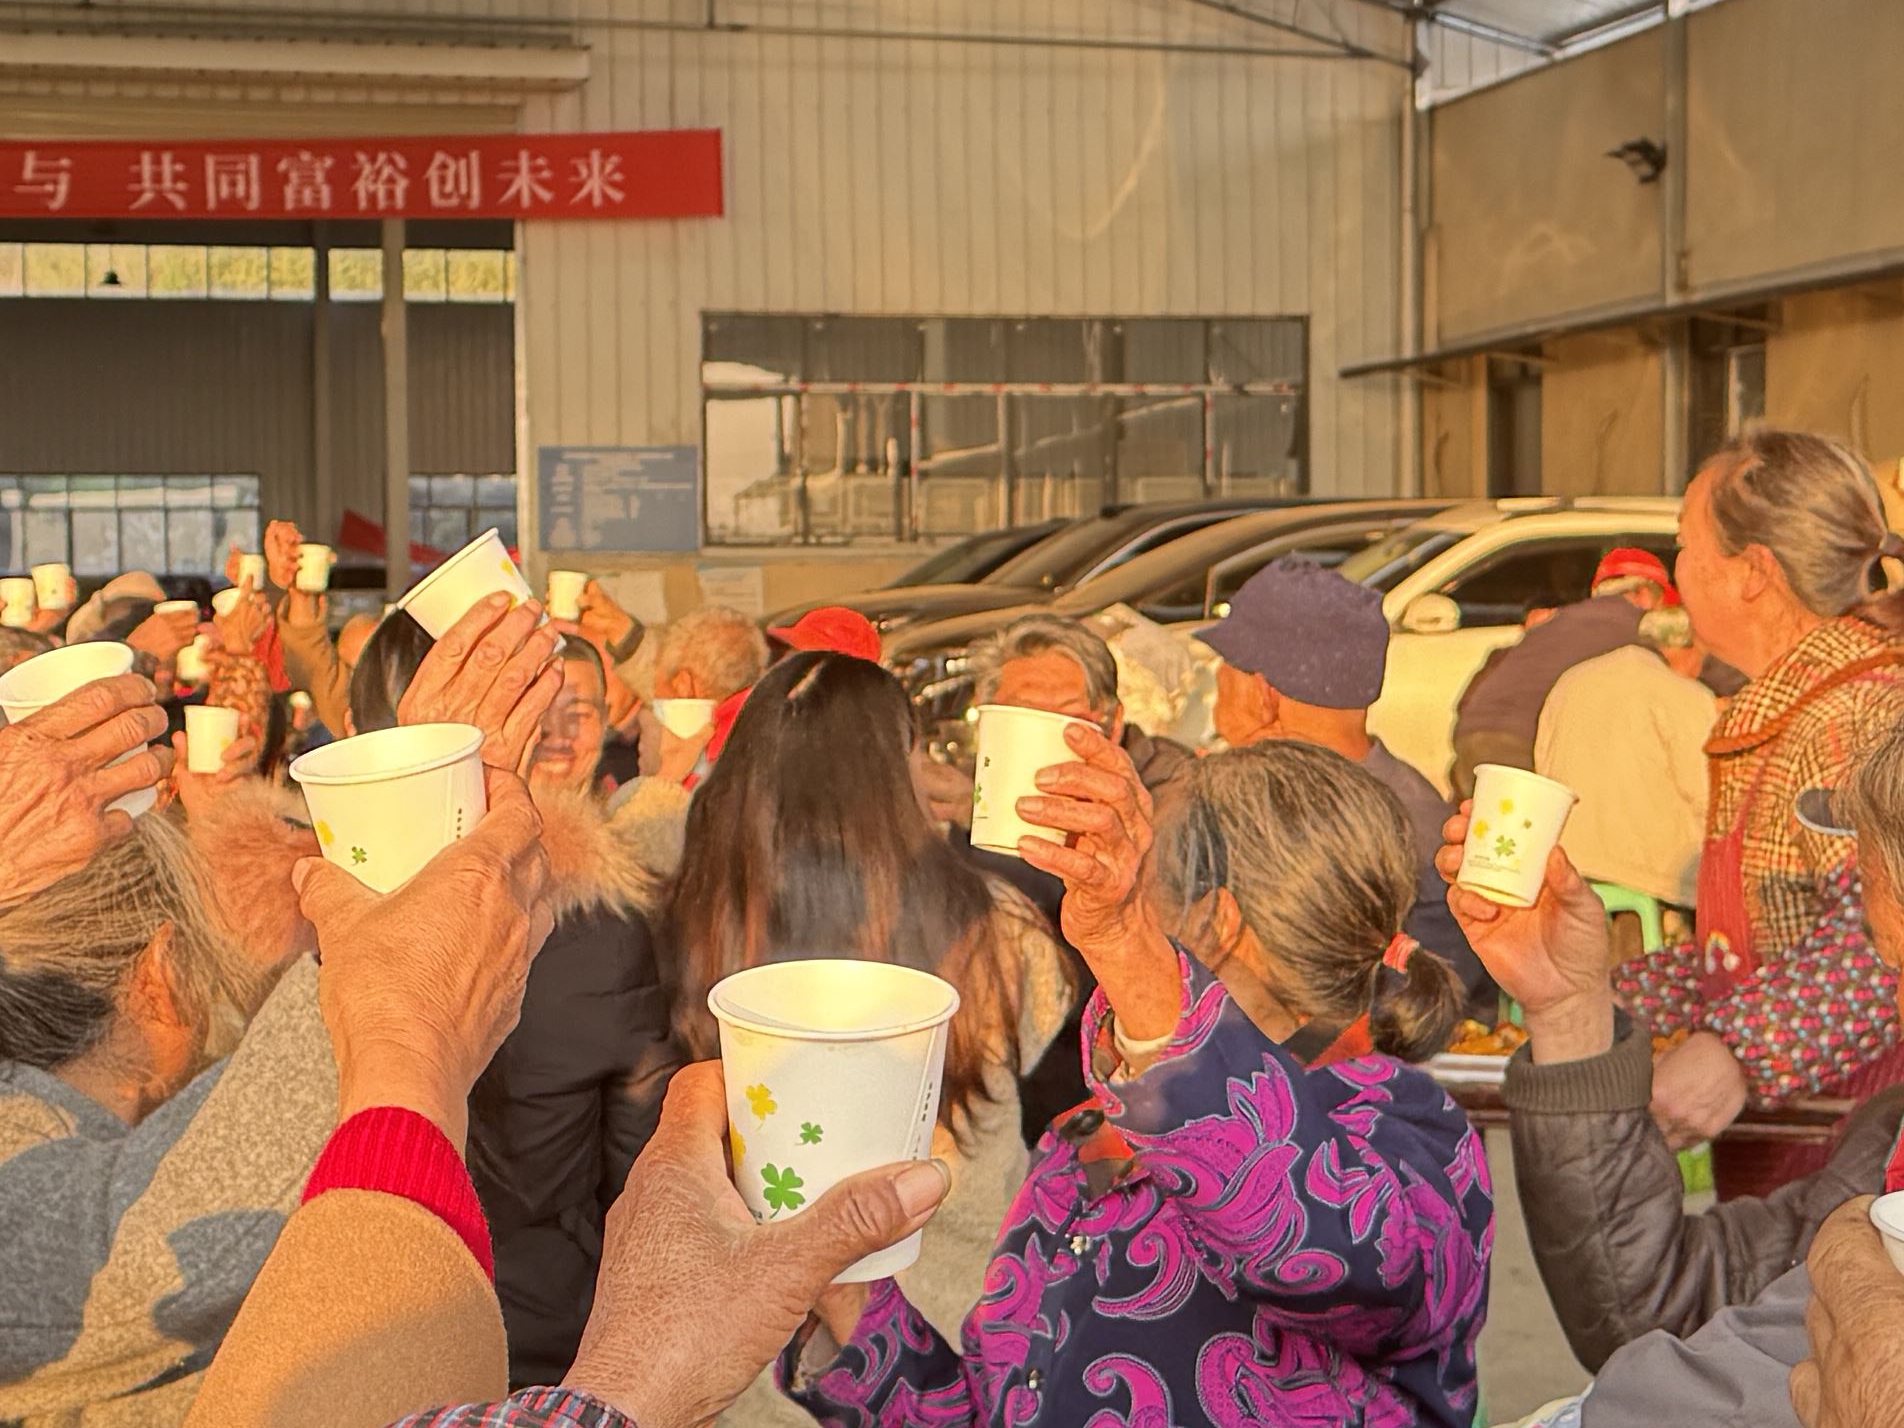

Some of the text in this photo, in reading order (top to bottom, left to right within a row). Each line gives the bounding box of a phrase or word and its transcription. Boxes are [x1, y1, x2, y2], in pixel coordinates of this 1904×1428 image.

[127, 149, 627, 211] 共同富裕创未来
